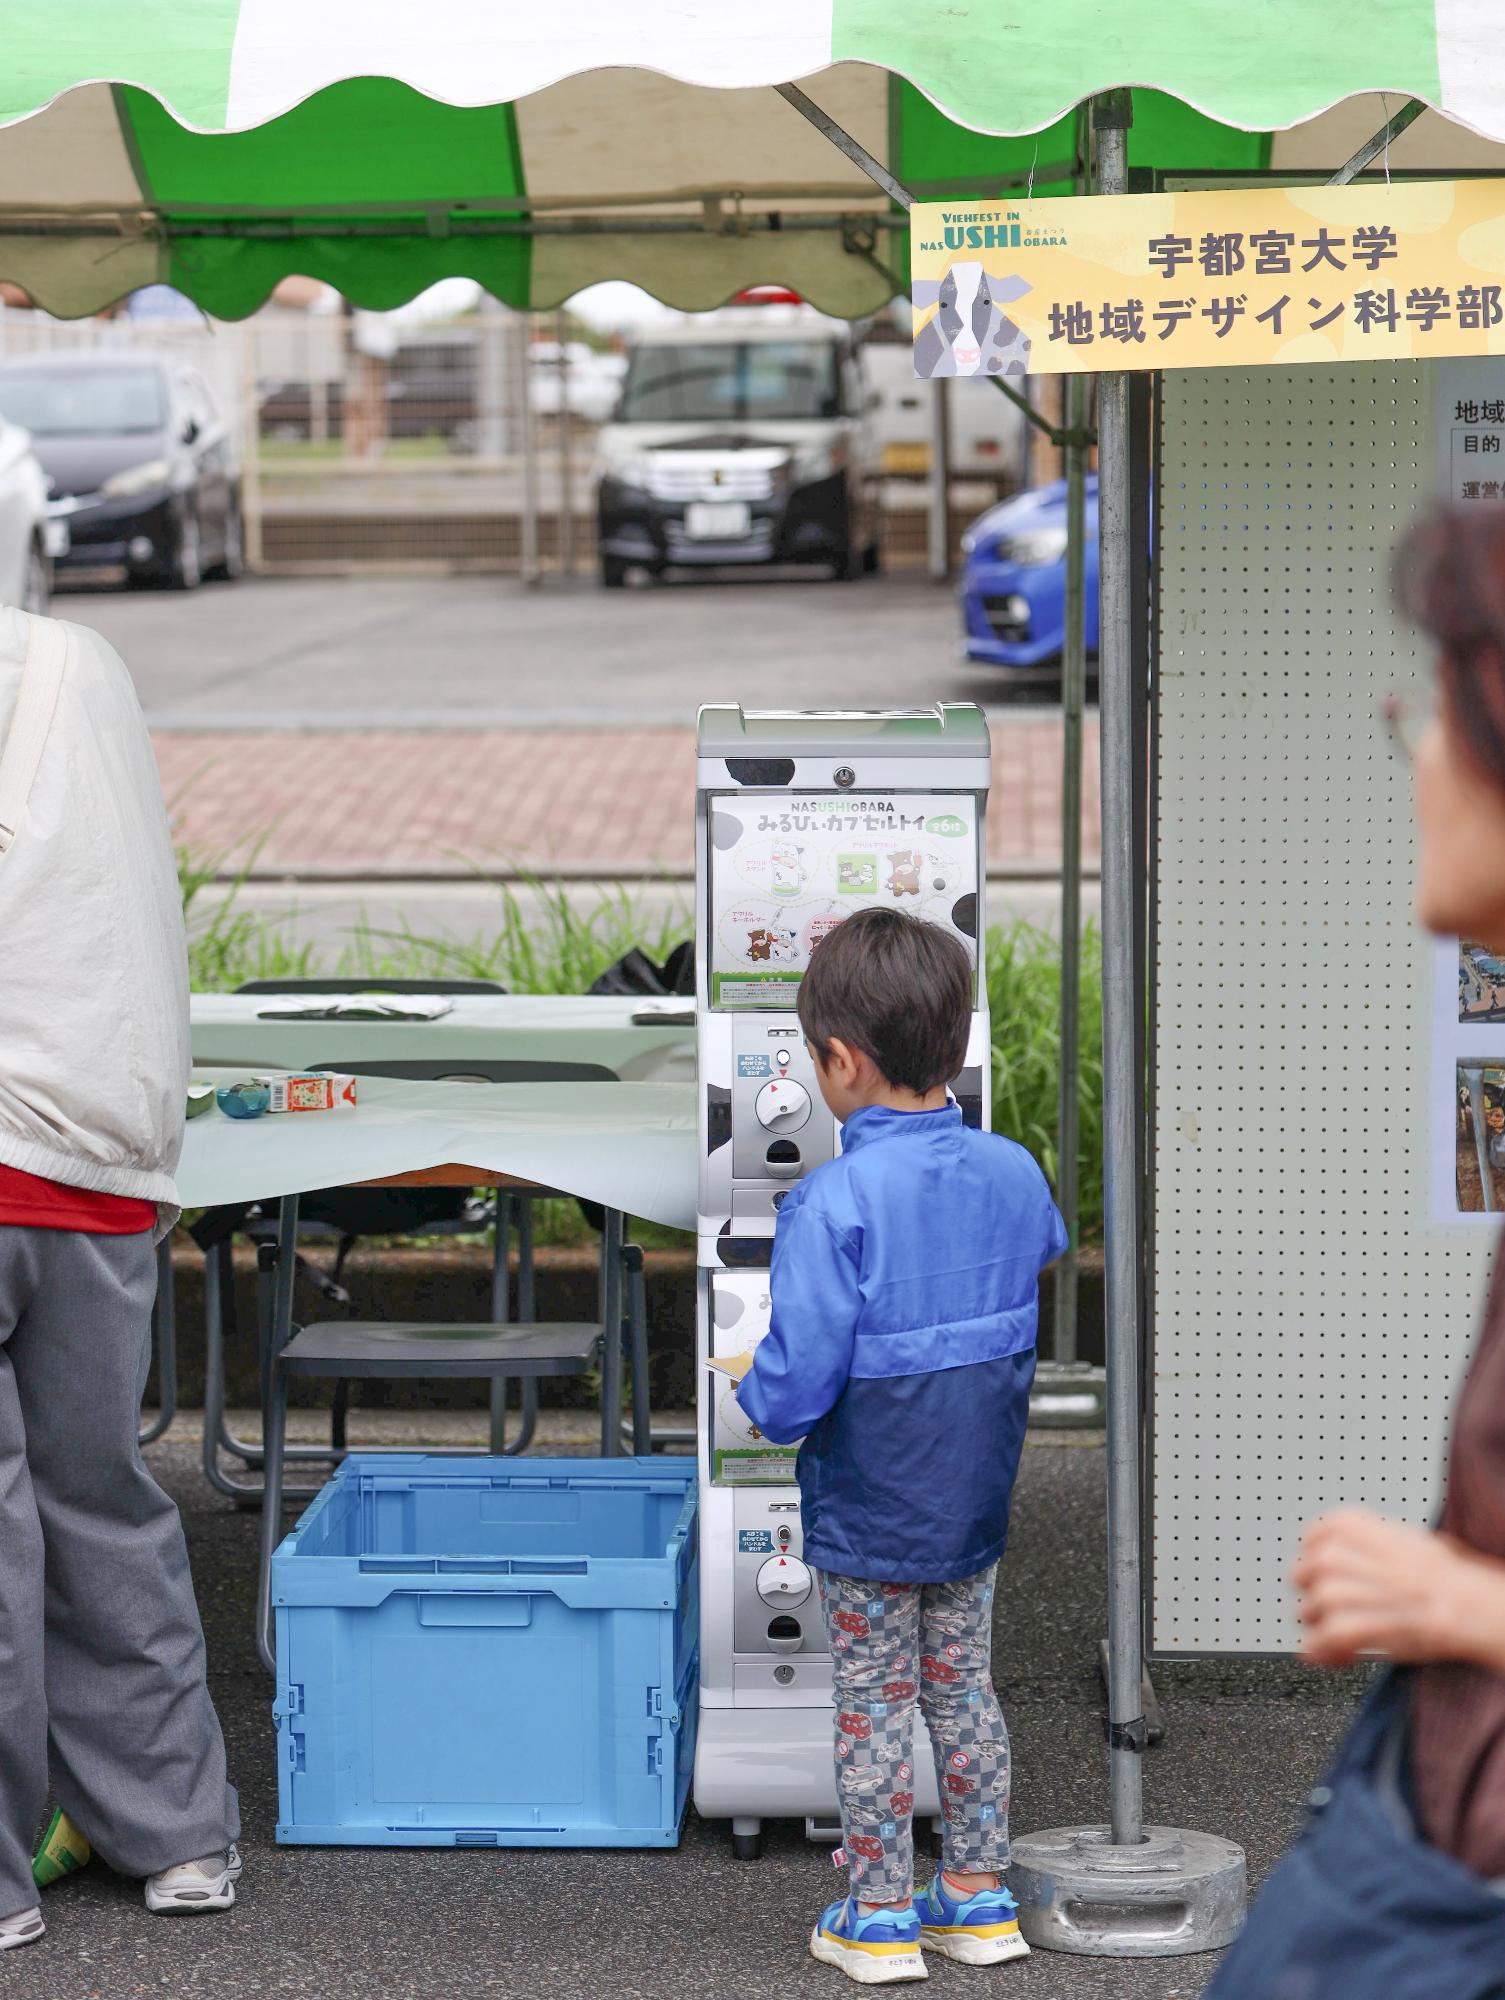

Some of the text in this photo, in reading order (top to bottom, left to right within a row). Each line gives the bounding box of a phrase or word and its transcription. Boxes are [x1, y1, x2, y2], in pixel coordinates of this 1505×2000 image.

[942, 211, 1020, 223] VIEHFEST IN
[1023, 236, 1068, 247] OBARA
[1148, 225, 1398, 278] 宇都宮大学
[1048, 285, 1502, 345] 地域デザイン科学部
[1464, 435, 1500, 453] 目的
[1461, 480, 1505, 499] 運営
[791, 801, 895, 813] NASUSHIOBARA
